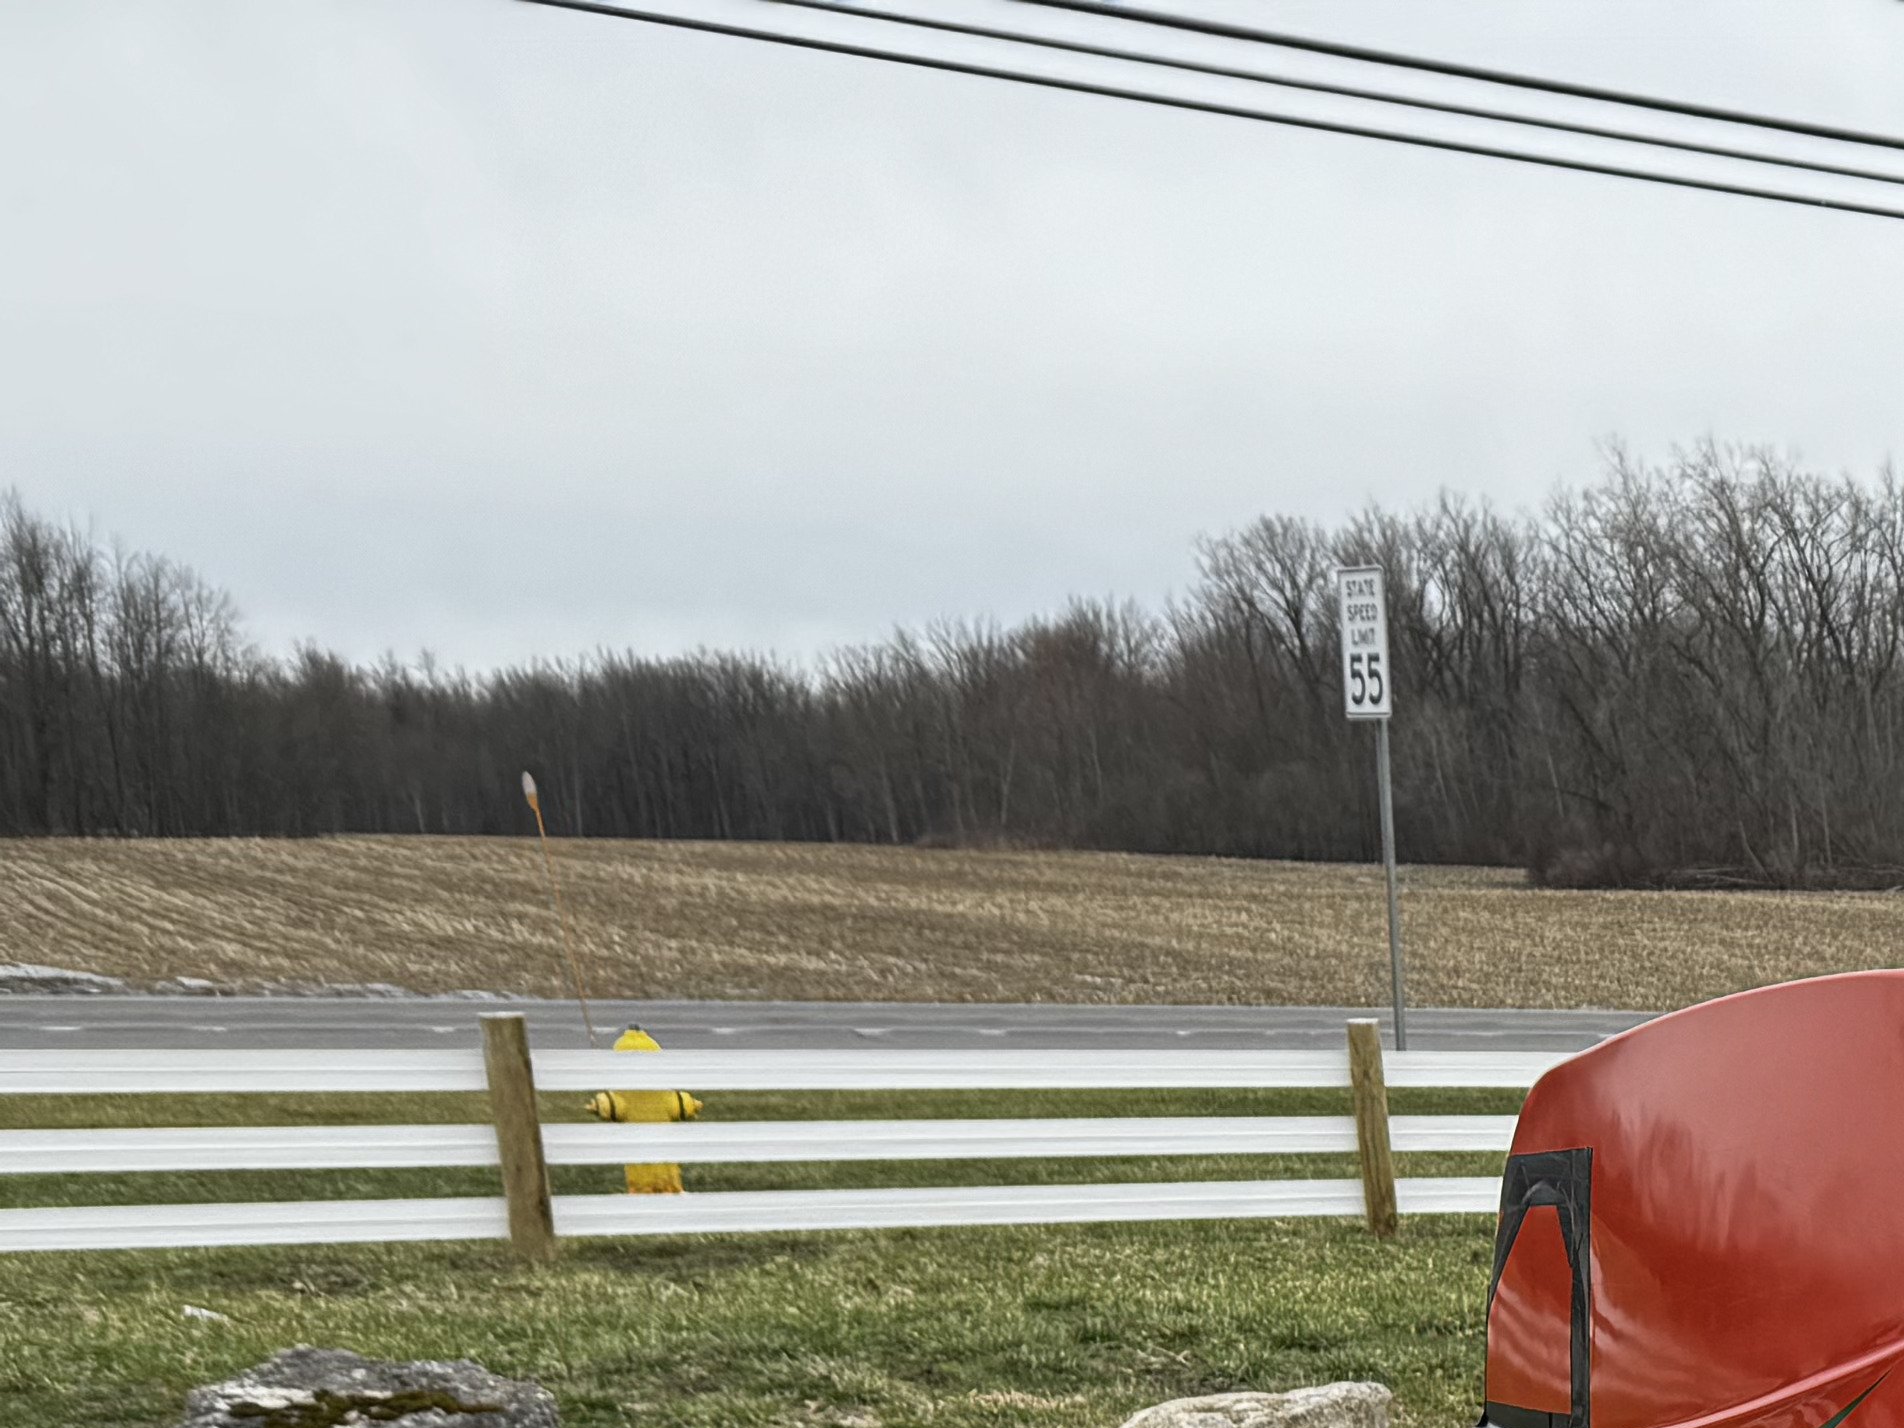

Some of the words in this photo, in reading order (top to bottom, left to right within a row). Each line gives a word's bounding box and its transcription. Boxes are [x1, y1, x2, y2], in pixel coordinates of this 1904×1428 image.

[1346, 579, 1376, 599] STATE
[1347, 603, 1378, 622] SPEED
[1351, 627, 1376, 646] LIMIT
[1350, 652, 1384, 706] 55
